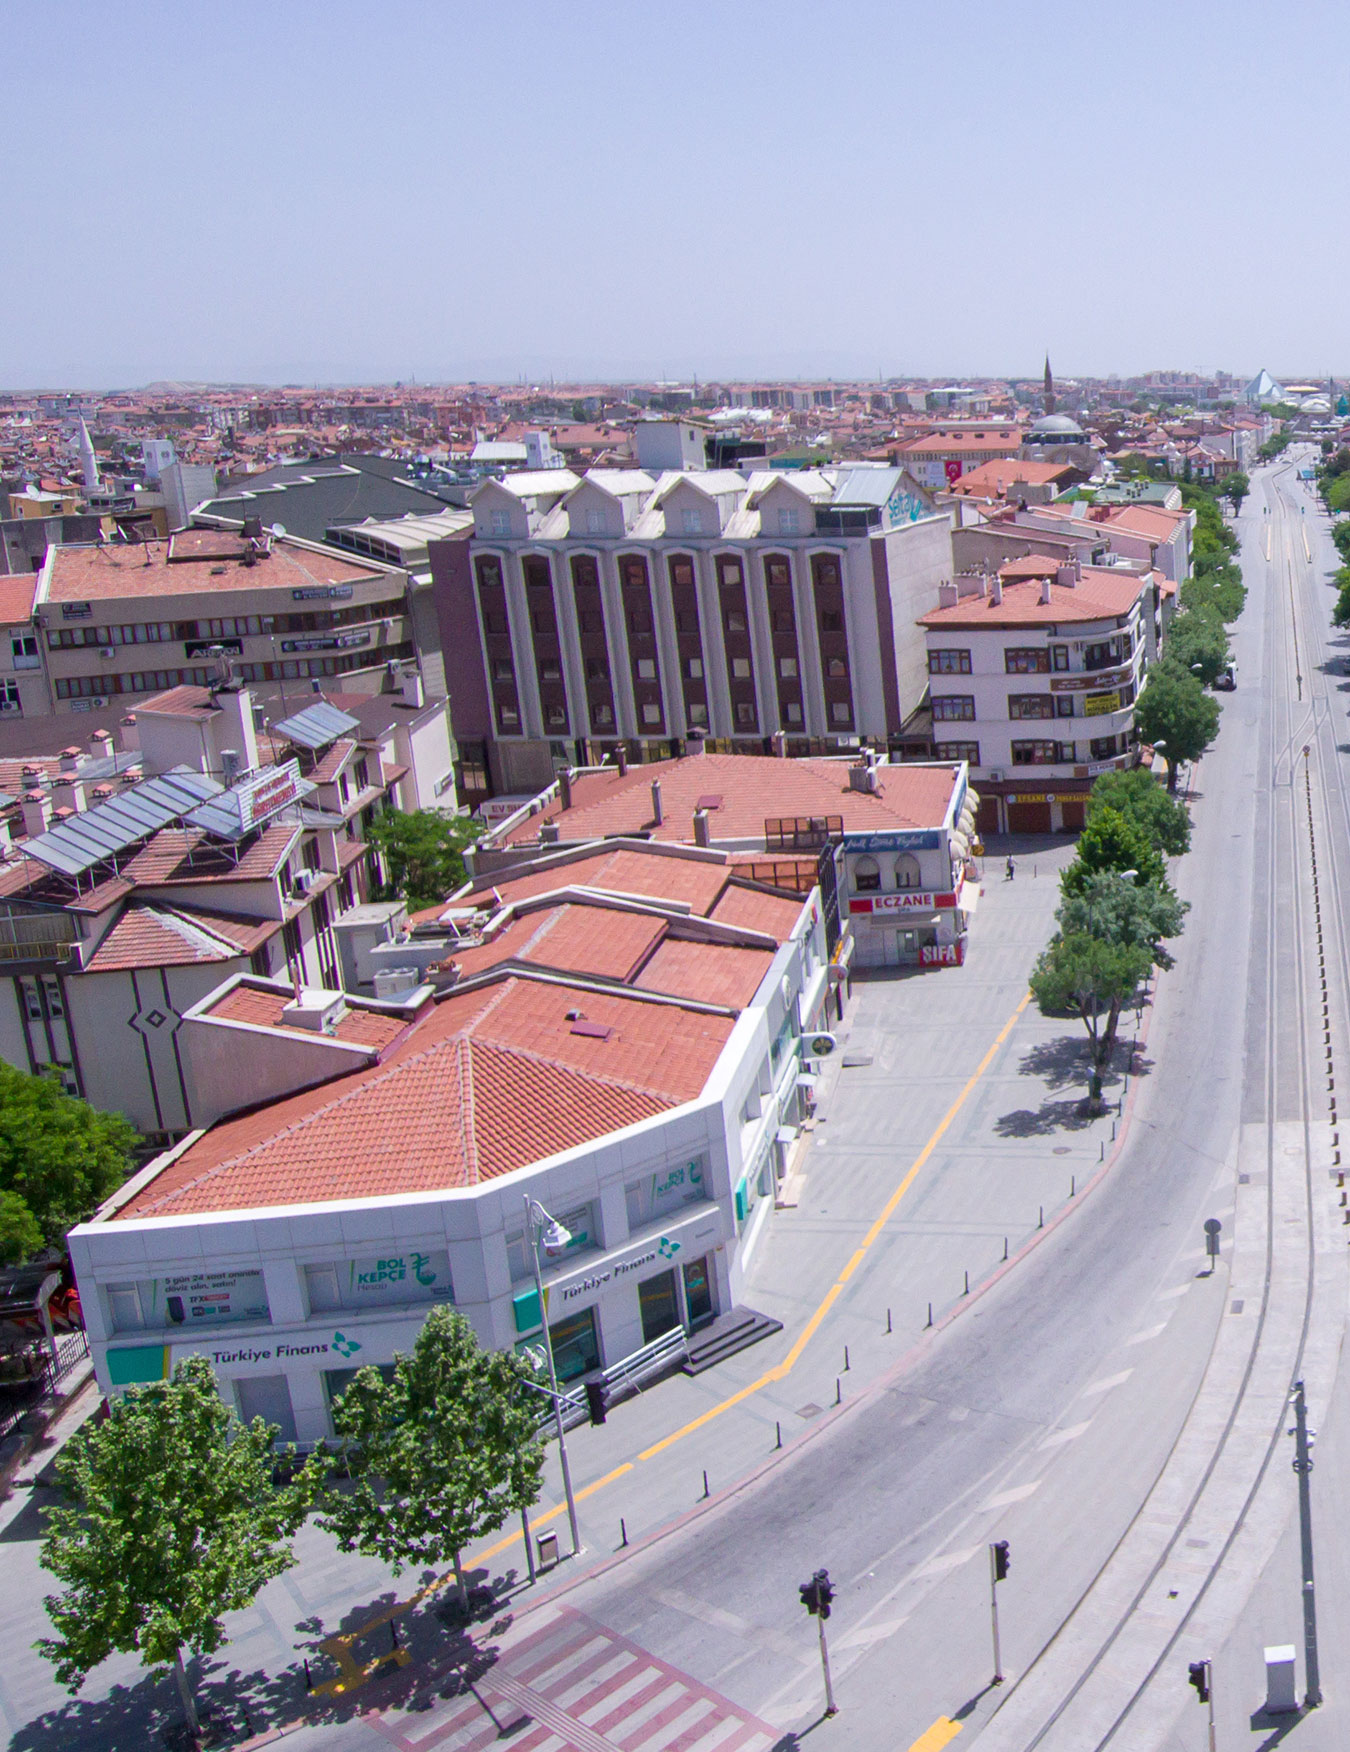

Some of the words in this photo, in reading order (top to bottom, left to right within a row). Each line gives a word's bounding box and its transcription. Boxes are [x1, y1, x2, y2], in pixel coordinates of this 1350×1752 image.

[875, 894, 931, 908] ECZANE
[377, 1258, 406, 1271] BOL
[173, 1275, 190, 1285] gün
[206, 1271, 226, 1280] saat
[358, 1269, 406, 1284] KEPÇE
[561, 1271, 611, 1300] Türkiye
[614, 1250, 656, 1278] Finans
[165, 1284, 188, 1293] döviz
[212, 1350, 271, 1364] Türkiye
[276, 1342, 329, 1358] Finans
